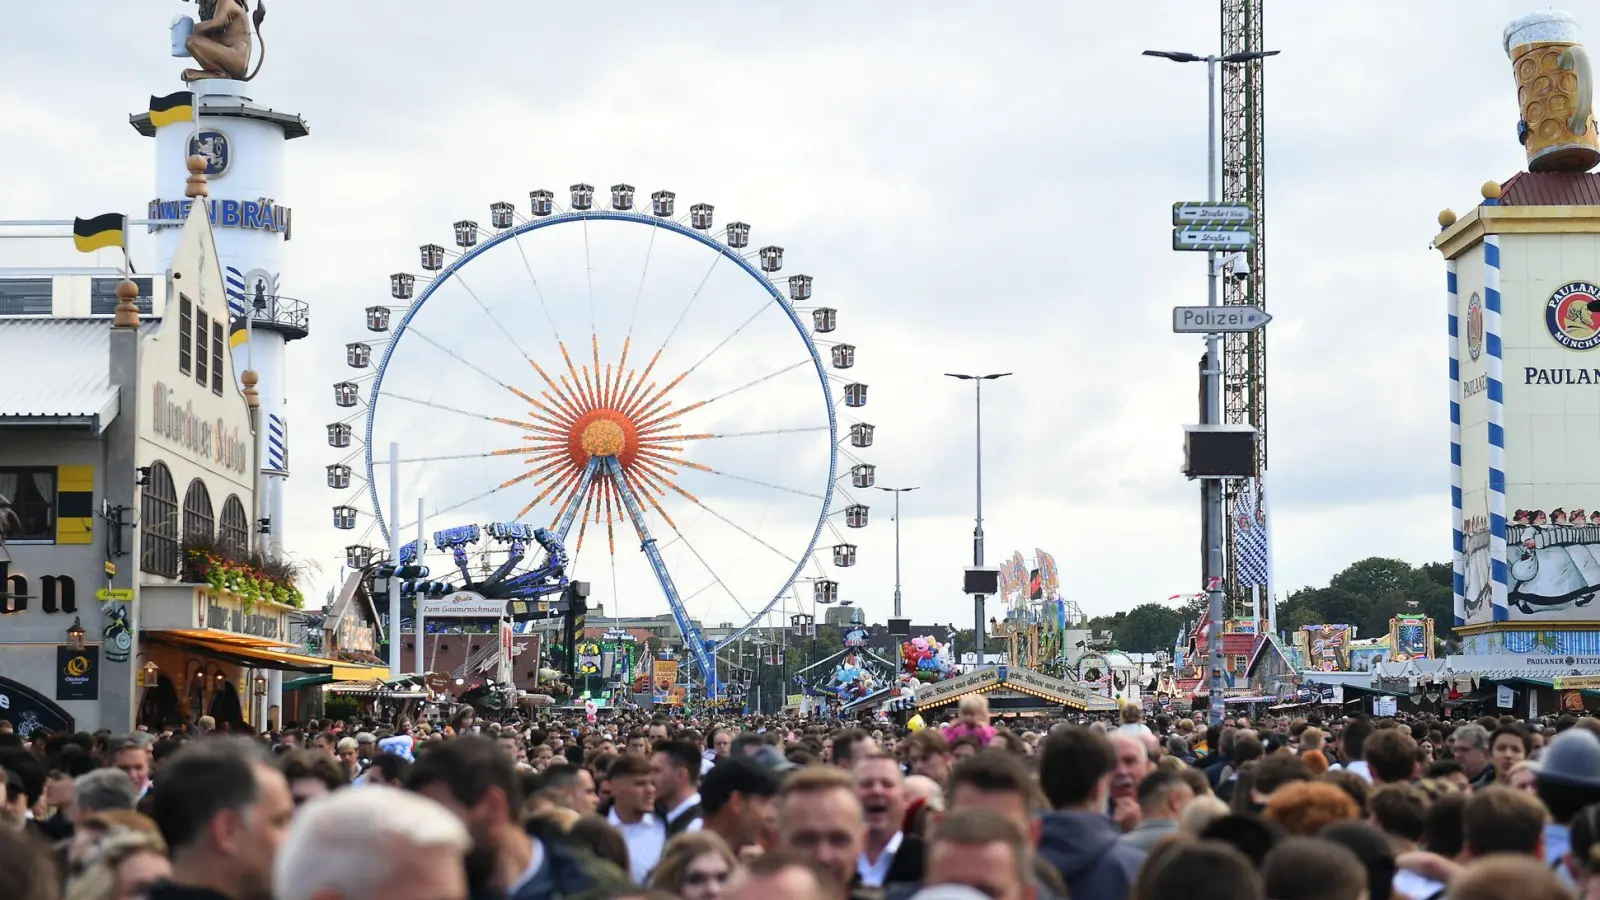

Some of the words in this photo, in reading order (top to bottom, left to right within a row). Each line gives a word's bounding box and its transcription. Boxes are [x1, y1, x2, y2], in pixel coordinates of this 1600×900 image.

[1184, 310, 1244, 325] Polizei
[423, 605, 440, 613] Zum
[441, 605, 502, 613] Gaumenschmaus
[1526, 657, 1564, 665] PAULANER
